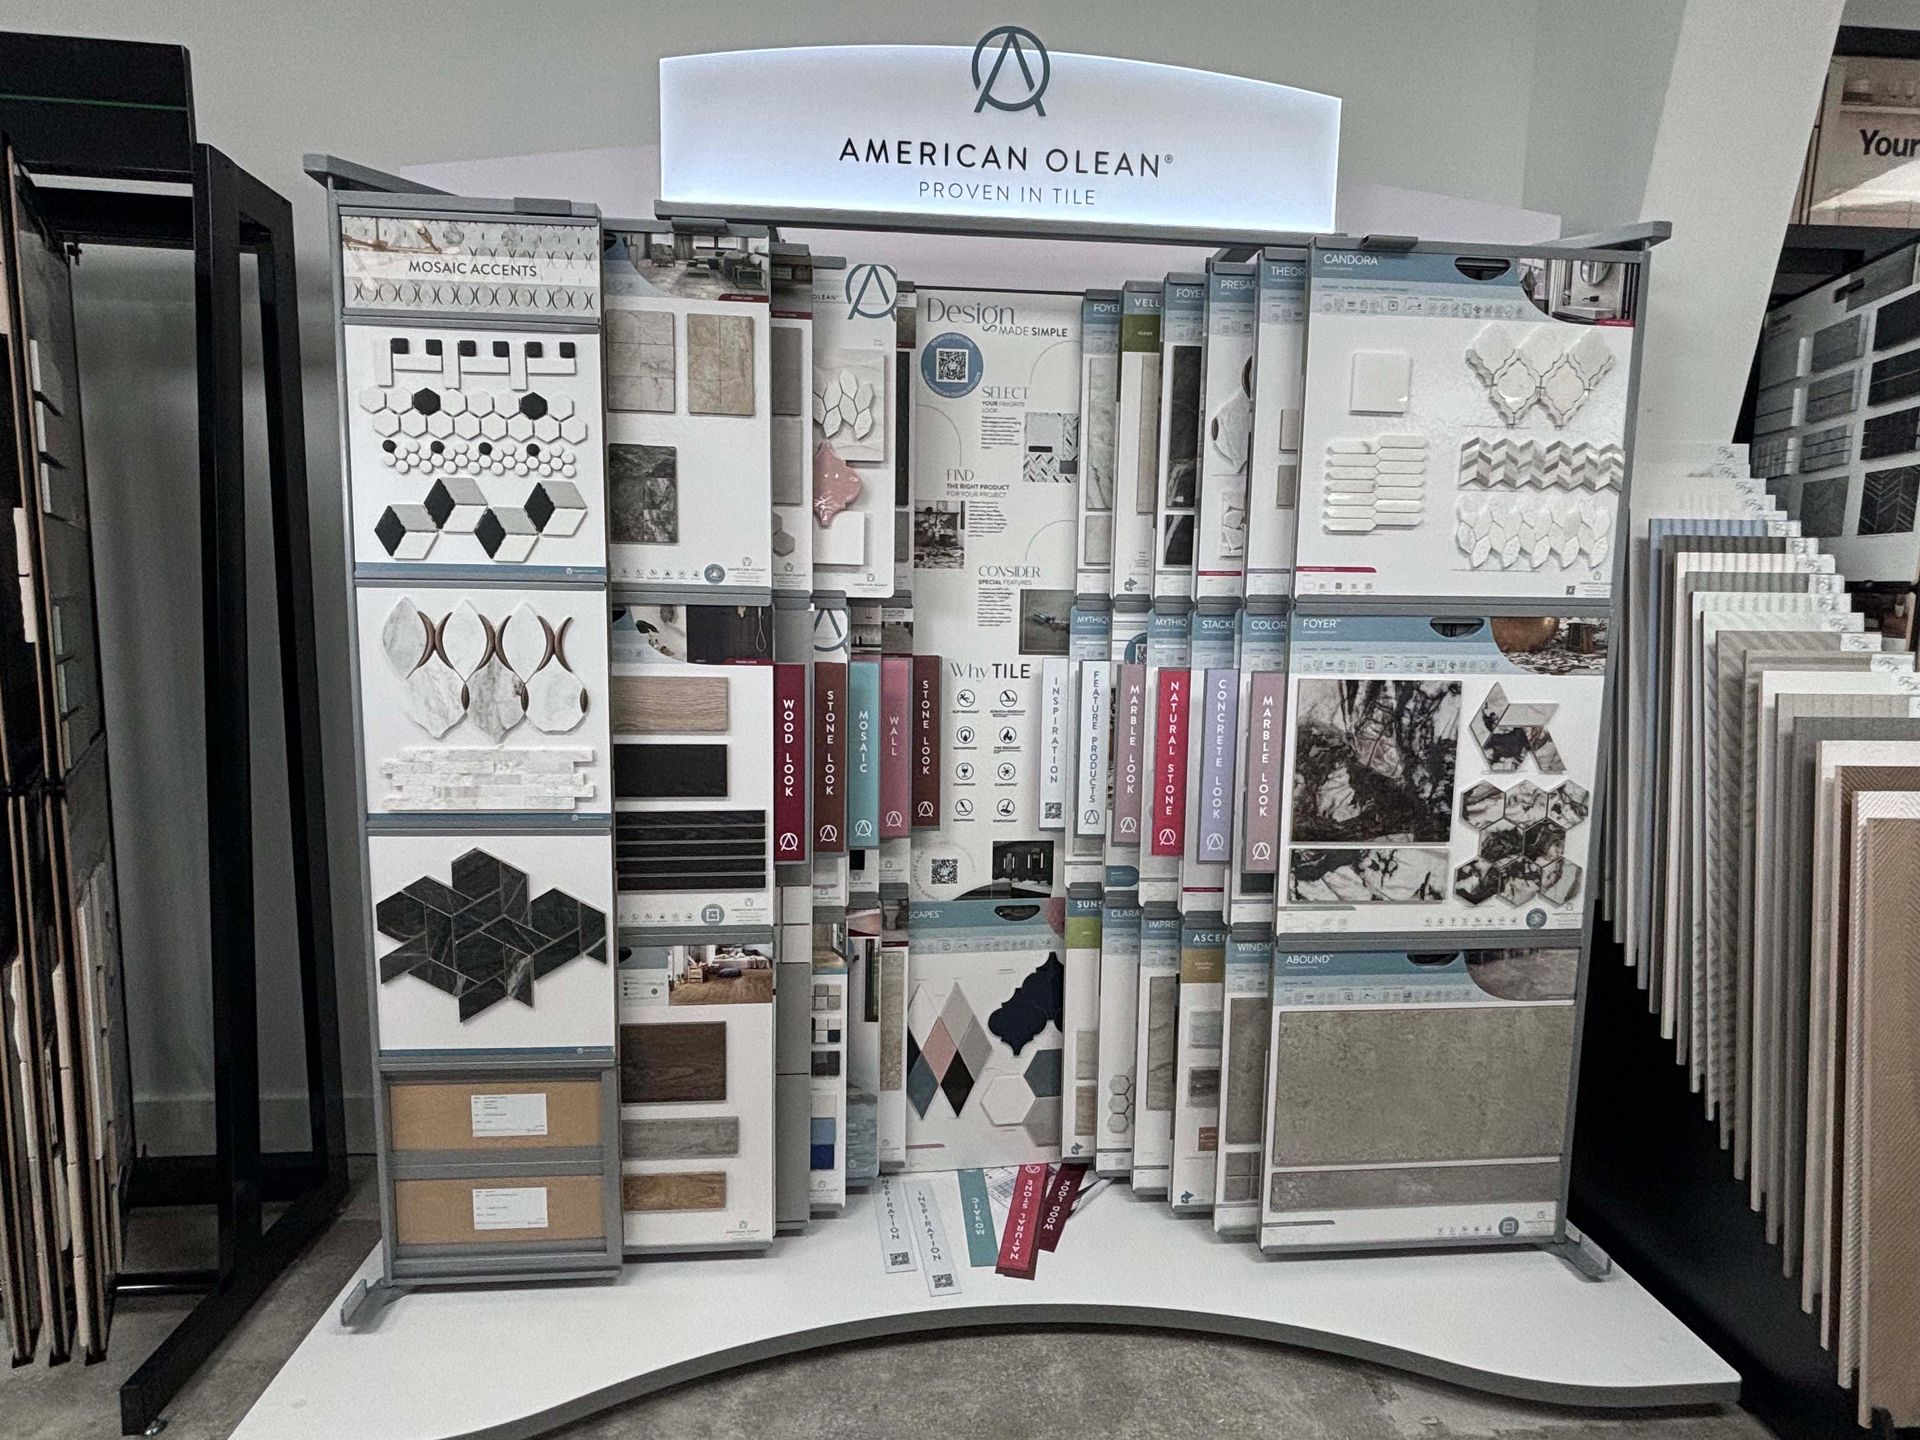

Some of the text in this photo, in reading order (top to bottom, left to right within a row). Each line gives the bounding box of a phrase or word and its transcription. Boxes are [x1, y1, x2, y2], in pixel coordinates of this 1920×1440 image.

[839, 137, 1029, 171] AMERICAN
[1859, 128, 1920, 158] Your
[919, 180, 1096, 206] PROVEN IN TILE
[408, 260, 537, 277] MOSAIC ACCENTS
[1323, 253, 1379, 266] CANDORA
[1176, 288, 1204, 298] FOYE
[926, 297, 1016, 332] Design
[998, 326, 1068, 338] MADE SIMPLE
[981, 386, 1031, 400] SELECT
[946, 469, 975, 482] FIND
[960, 483, 979, 491] RIGHT
[978, 565, 1041, 578] CONSIDER
[1251, 620, 1287, 630] COLOR
[950, 663, 1031, 683] Why TILE
[825, 690, 835, 795] STONE LOOK
[858, 710, 869, 773] MOSAIC
[888, 716, 900, 756] WALL
[922, 680, 930, 775] STONE LOOK
[1050, 677, 1060, 784] INSPIRATION
[1089, 671, 1100, 803] FEATURE PRODUCTS
[1126, 685, 1140, 794] MARBLE LOOK
[782, 699, 795, 797] WOOD LOOK
[1165, 681, 1180, 816] NATURAL STONE
[1212, 680, 1228, 819] CONCRETE LOOK
[1258, 696, 1274, 817] MARBLE LOOK
[972, 1198, 985, 1236] MOSAIC
[1010, 1179, 1034, 1260] NATURAL STONE
[1043, 1179, 1071, 1231] WOOD LOOK
[917, 1190, 942, 1262] INSPIRATION
